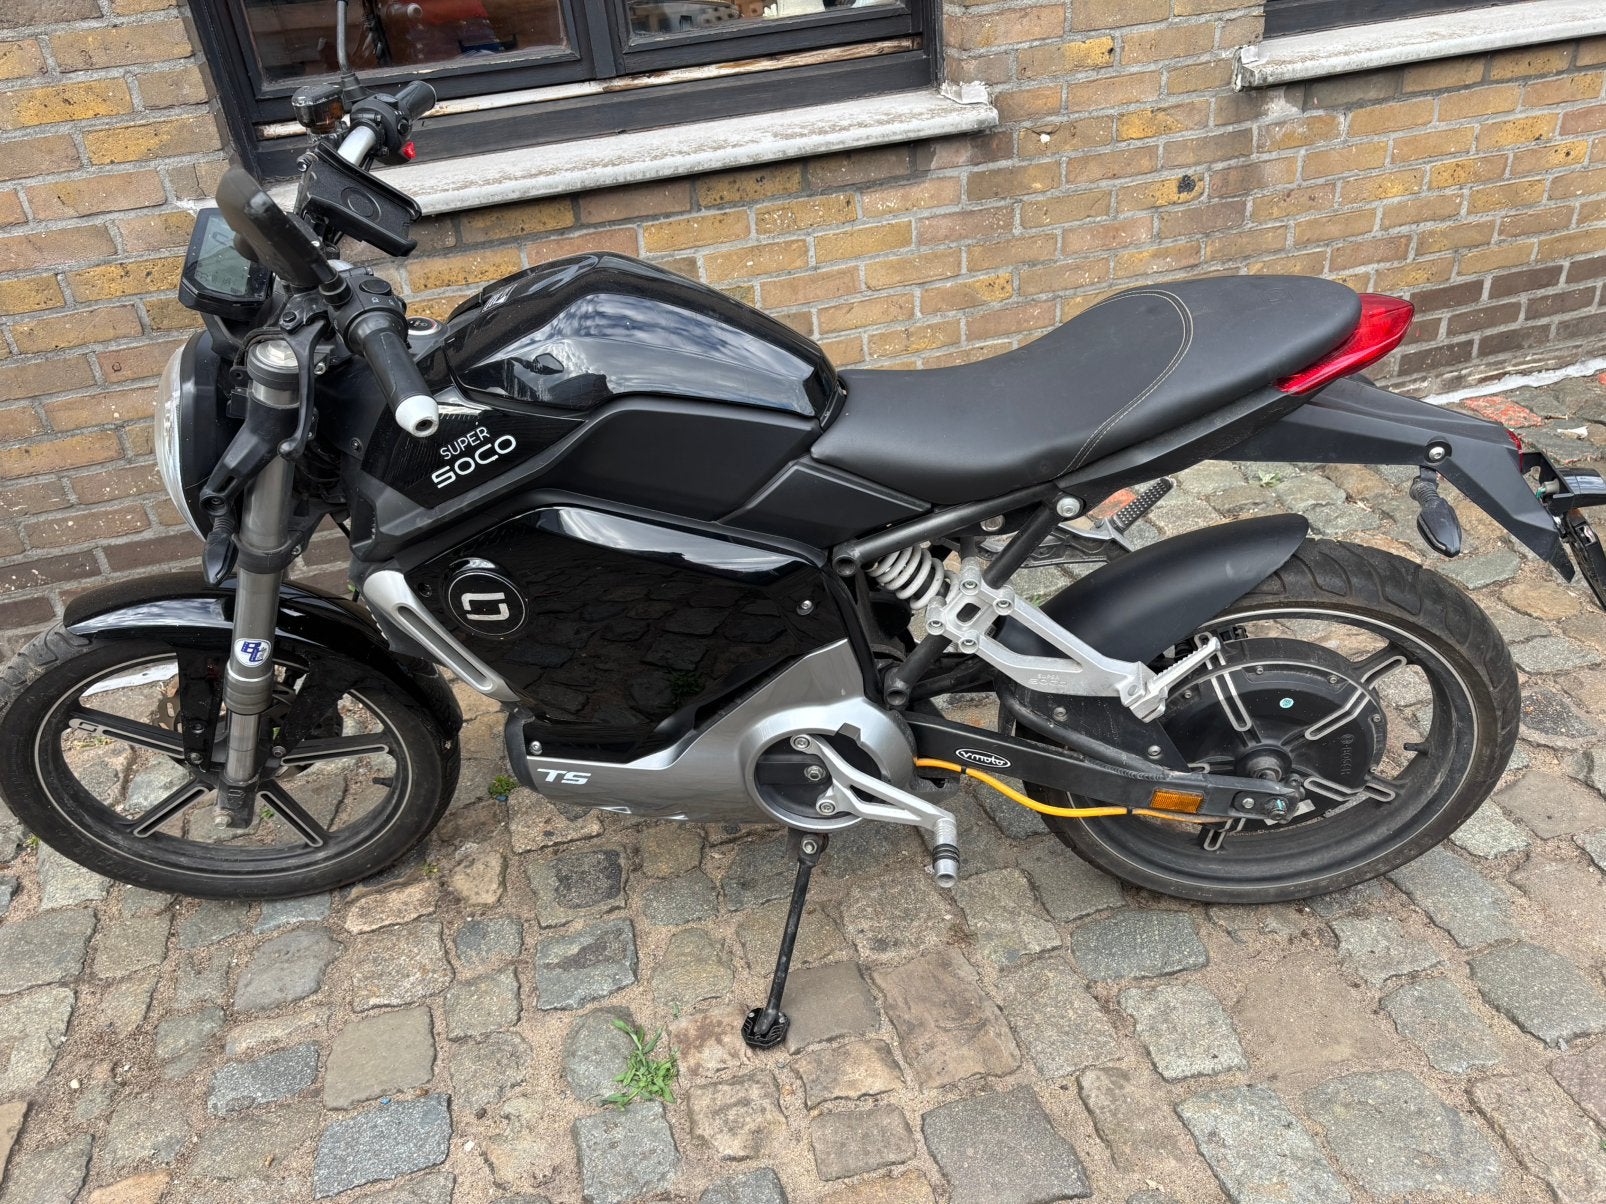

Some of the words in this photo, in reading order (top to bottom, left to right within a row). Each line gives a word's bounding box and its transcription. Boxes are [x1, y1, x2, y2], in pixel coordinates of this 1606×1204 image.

[440, 426, 490, 459] SUPER
[431, 435, 517, 489] SOCO
[537, 768, 592, 785] TS
